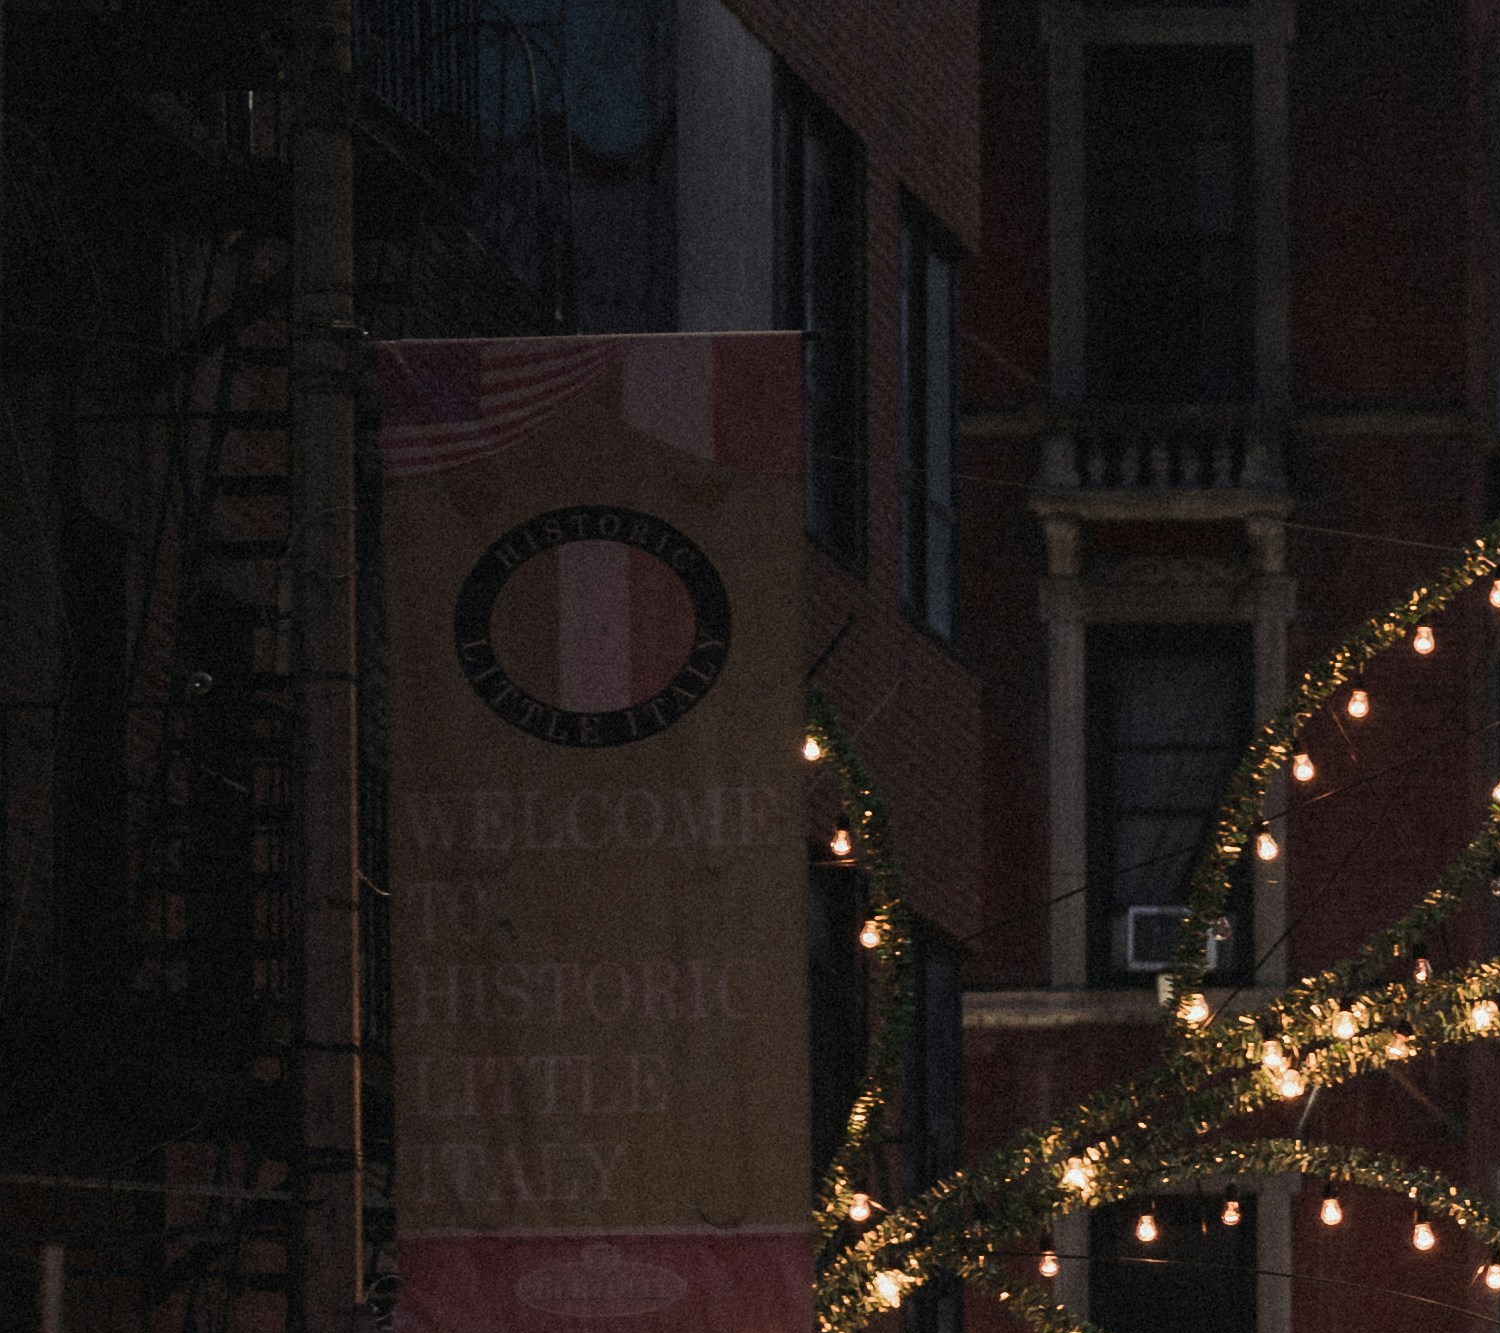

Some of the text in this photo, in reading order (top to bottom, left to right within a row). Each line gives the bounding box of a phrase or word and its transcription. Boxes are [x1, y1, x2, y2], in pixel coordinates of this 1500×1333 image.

[494, 513, 699, 572] HISTORIC
[462, 632, 724, 743] LITTLE ITALY
[400, 786, 780, 852] WELCOME
[406, 880, 490, 941] TO
[411, 960, 759, 1025] HISTORIC
[413, 1053, 670, 1117] LITTLE
[416, 1141, 624, 1205] ITALY
